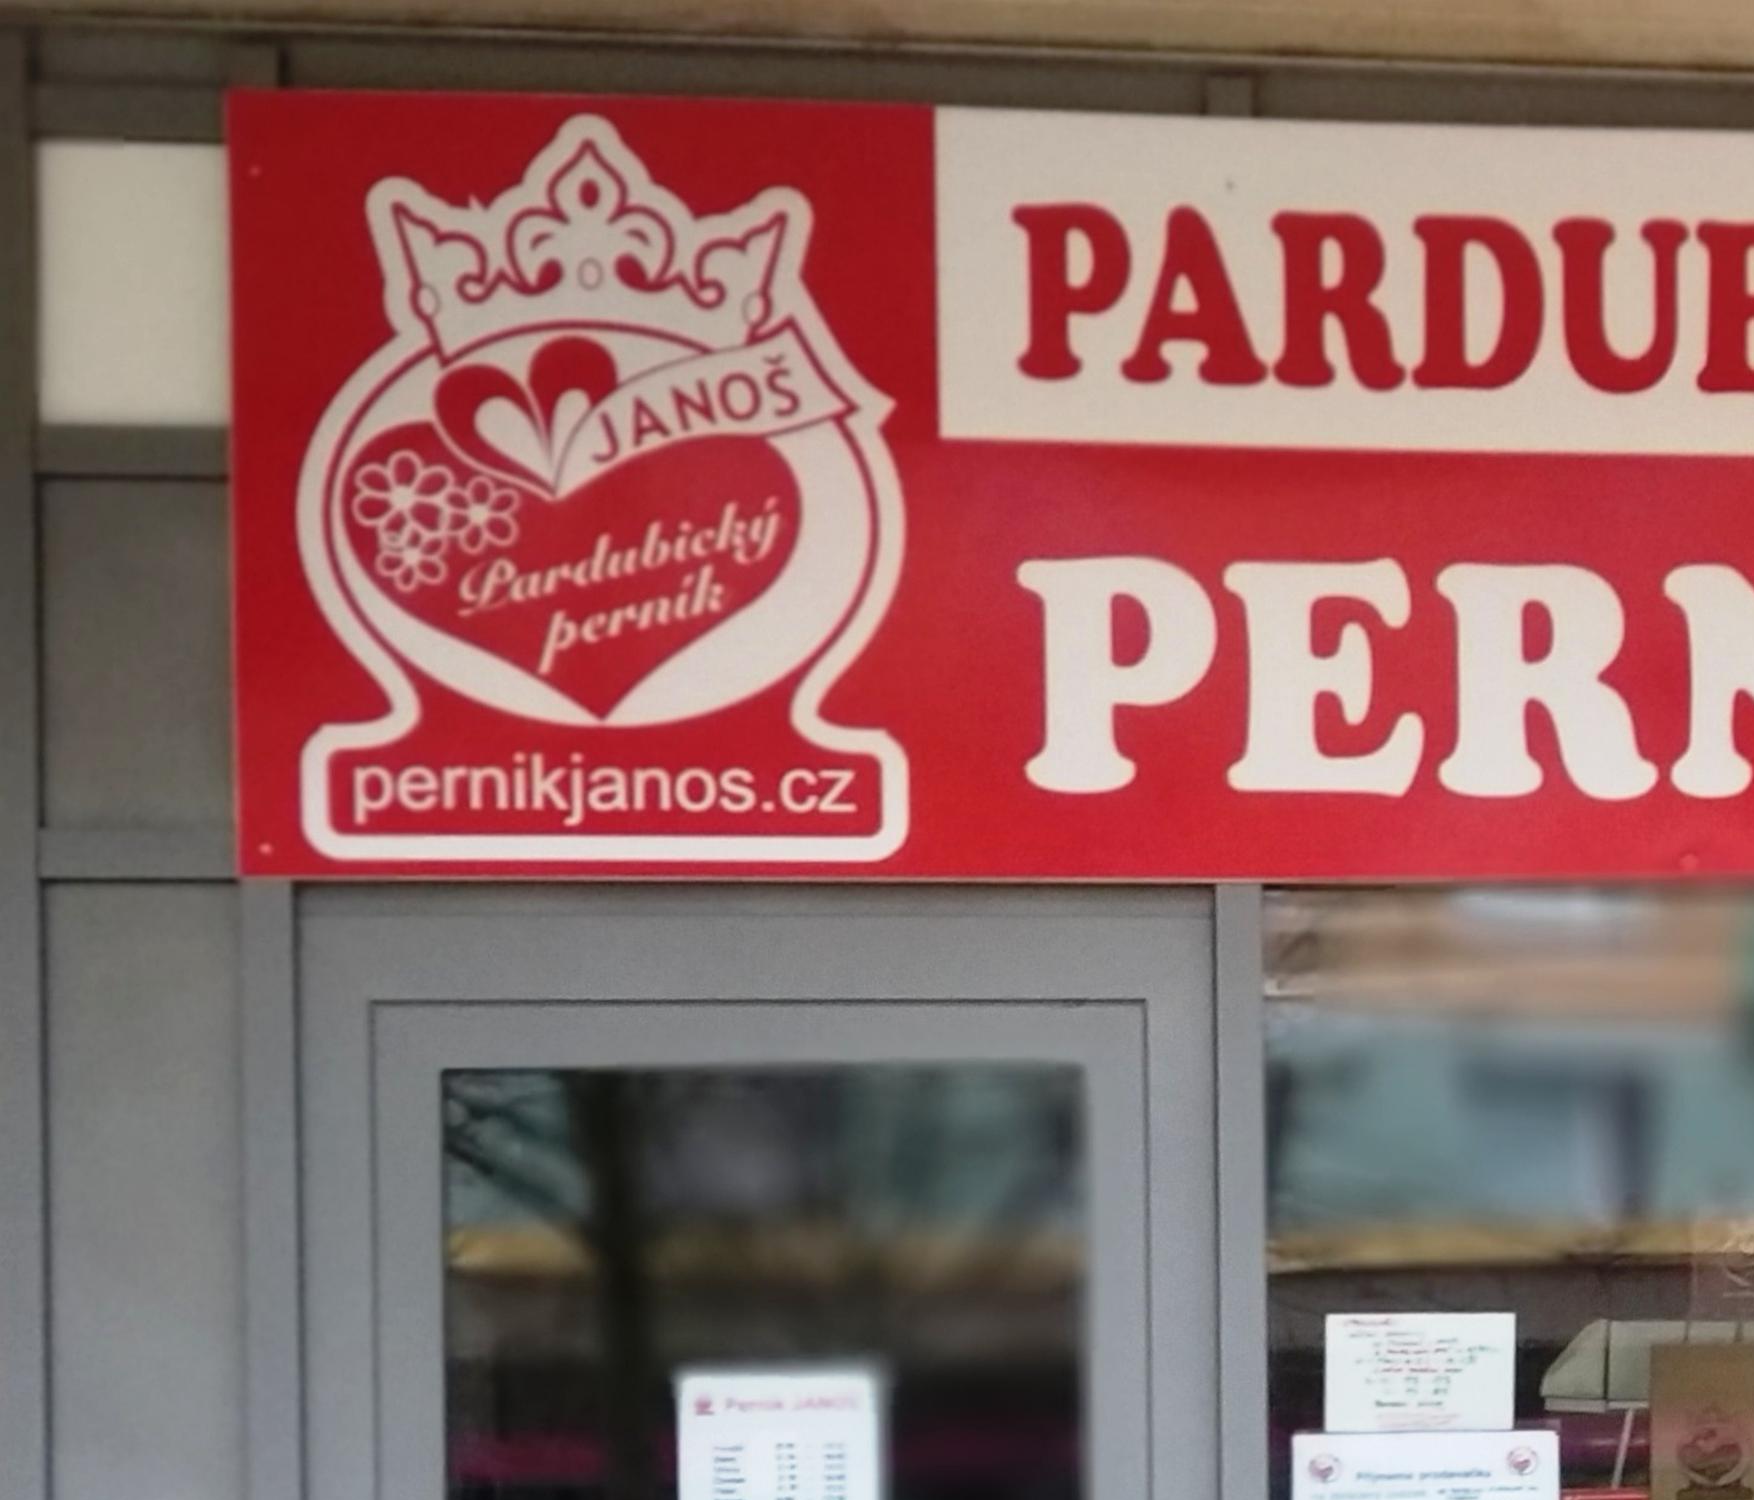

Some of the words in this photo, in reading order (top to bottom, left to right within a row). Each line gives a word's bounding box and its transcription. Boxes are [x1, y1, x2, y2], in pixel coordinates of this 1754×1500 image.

[592, 355, 800, 466] JANOŠ
[457, 496, 781, 616] Pardubický
[538, 565, 726, 674] perník
[353, 752, 858, 825] pernikjanos.cz
